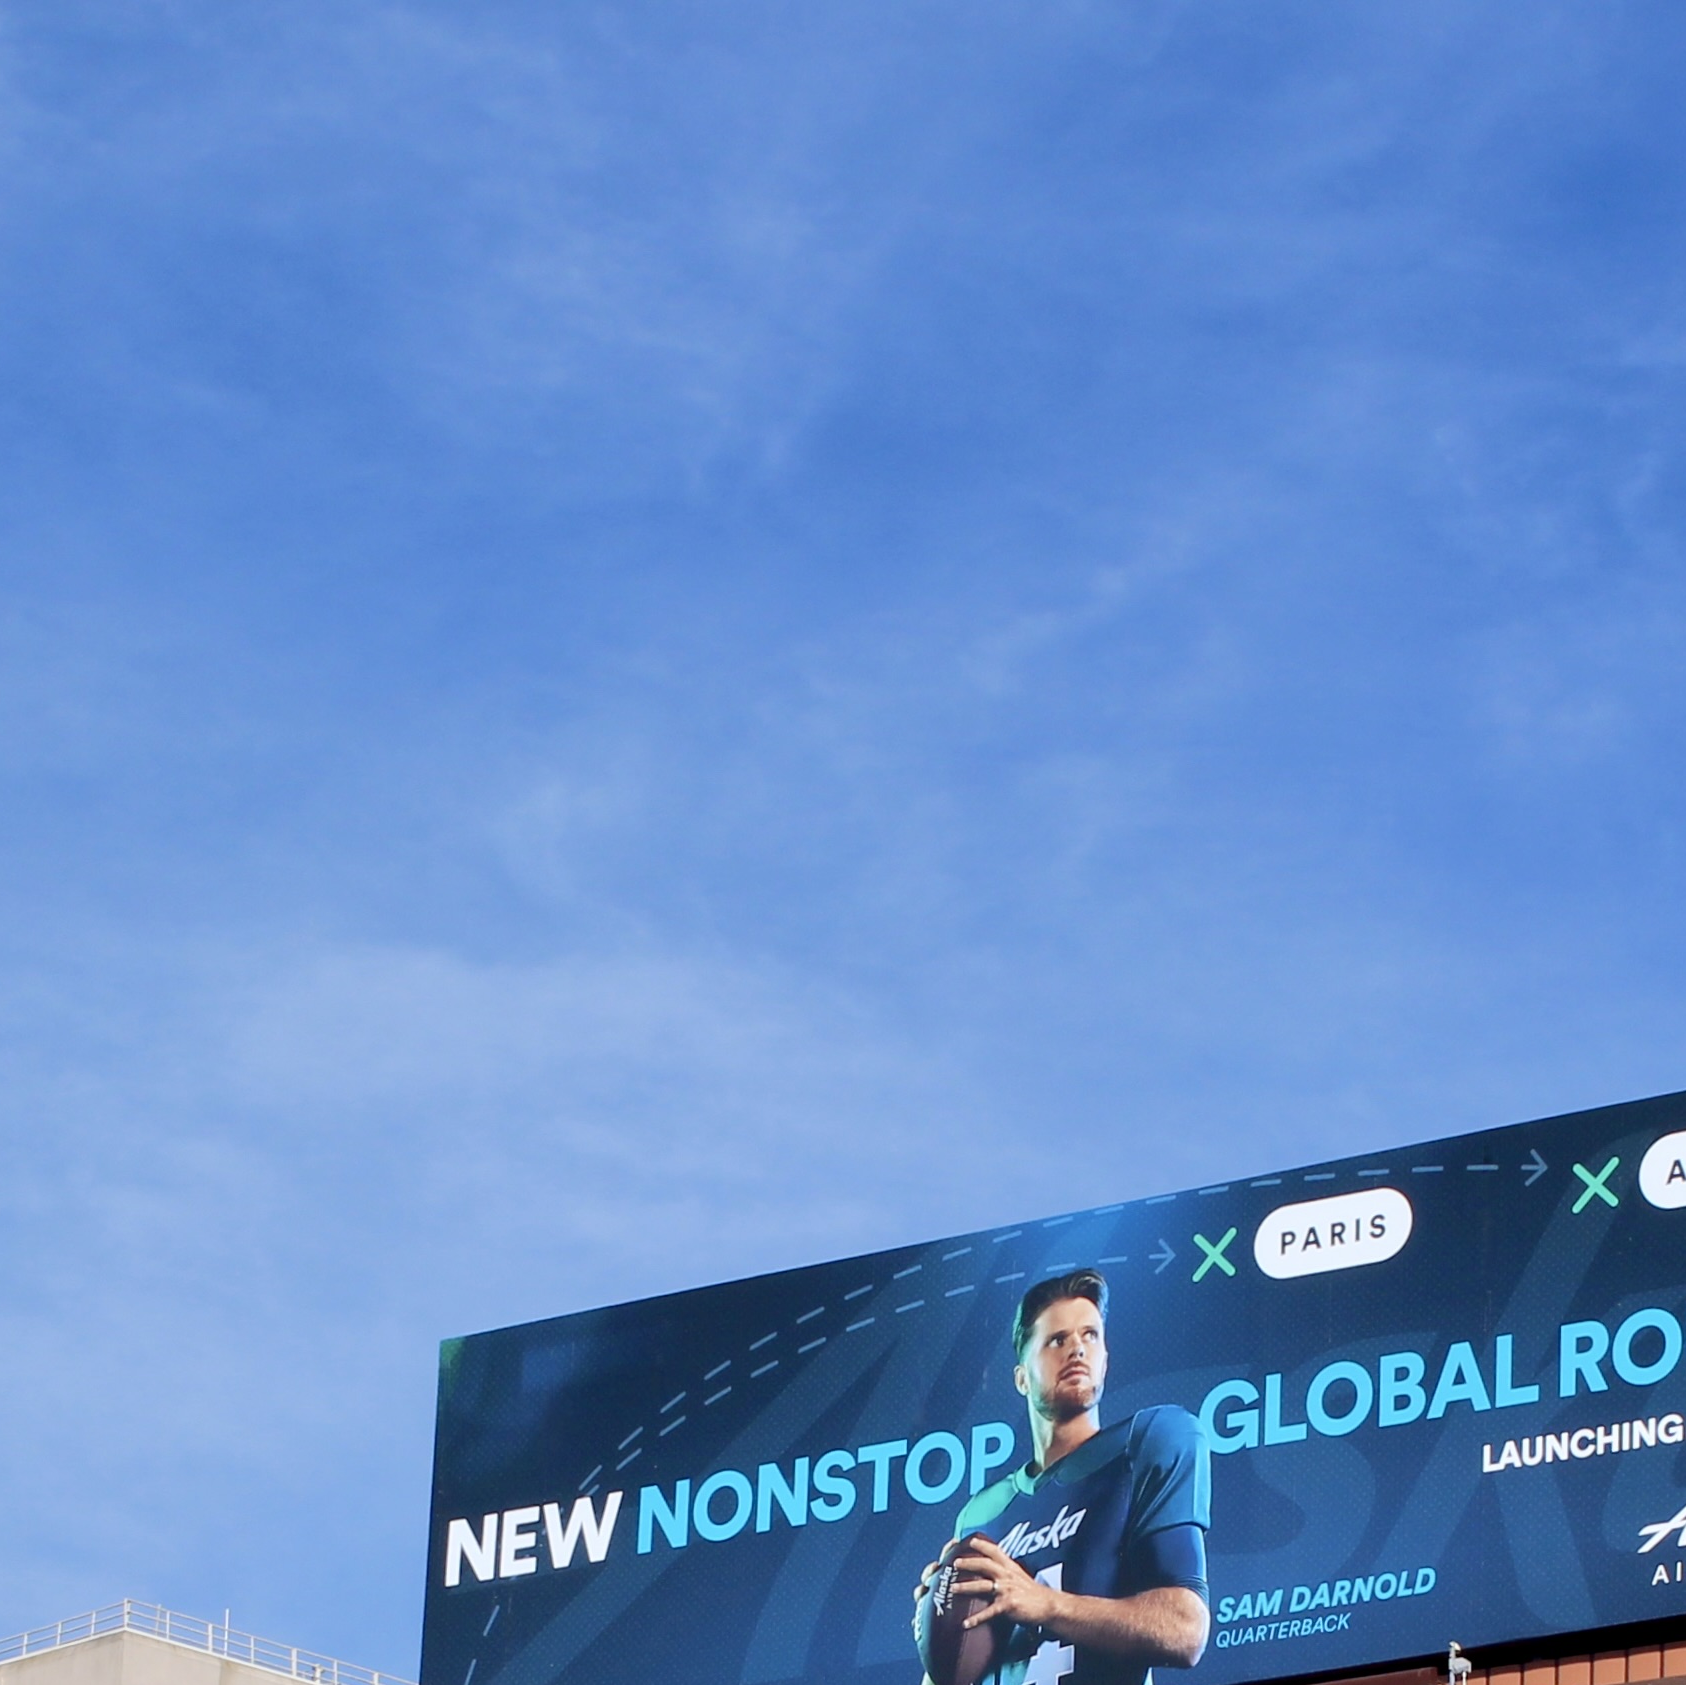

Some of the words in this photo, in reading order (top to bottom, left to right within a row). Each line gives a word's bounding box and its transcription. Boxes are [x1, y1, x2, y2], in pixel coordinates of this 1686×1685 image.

[1281, 1214, 1386, 1256] PARIS
[445, 1490, 623, 1587] NEW
[637, 1423, 1014, 1555] NONSTOP
[1197, 1334, 1540, 1456] GLOBAL
[1482, 1413, 1684, 1473] LAUNCHING
[1216, 1588, 1284, 1624] SAM
[1289, 1567, 1436, 1613] DARNOLD
[1215, 1612, 1351, 1649] QUARTERBACK
